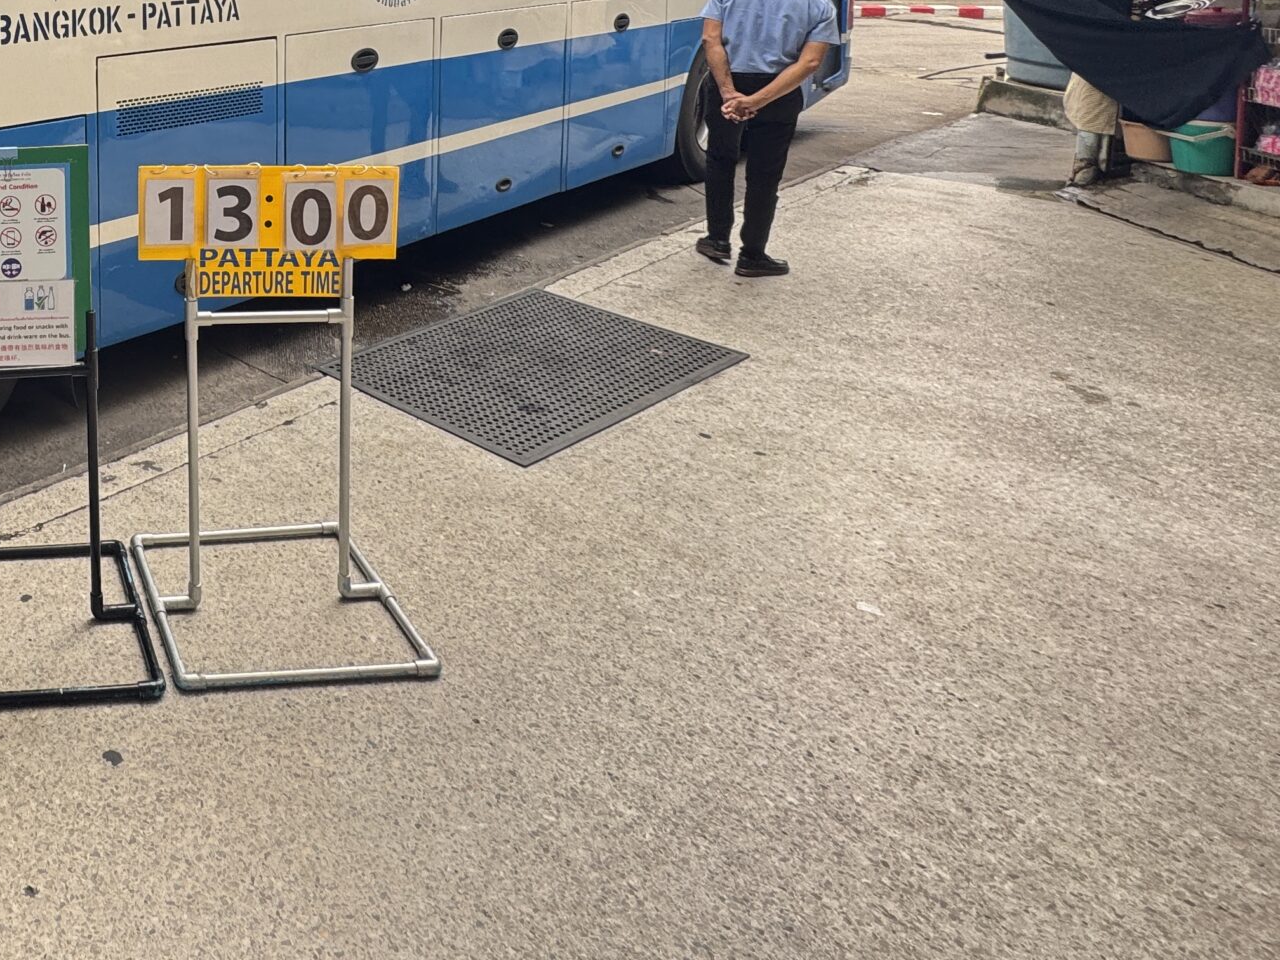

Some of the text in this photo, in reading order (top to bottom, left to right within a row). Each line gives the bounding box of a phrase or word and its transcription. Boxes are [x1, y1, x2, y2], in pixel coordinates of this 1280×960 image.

[8, 182, 38, 190] Condition
[158, 184, 390, 246] 13:00
[199, 248, 340, 268] PATTAYA
[199, 270, 340, 295] DEPARTURE TIME
[13, 323, 27, 331] food
